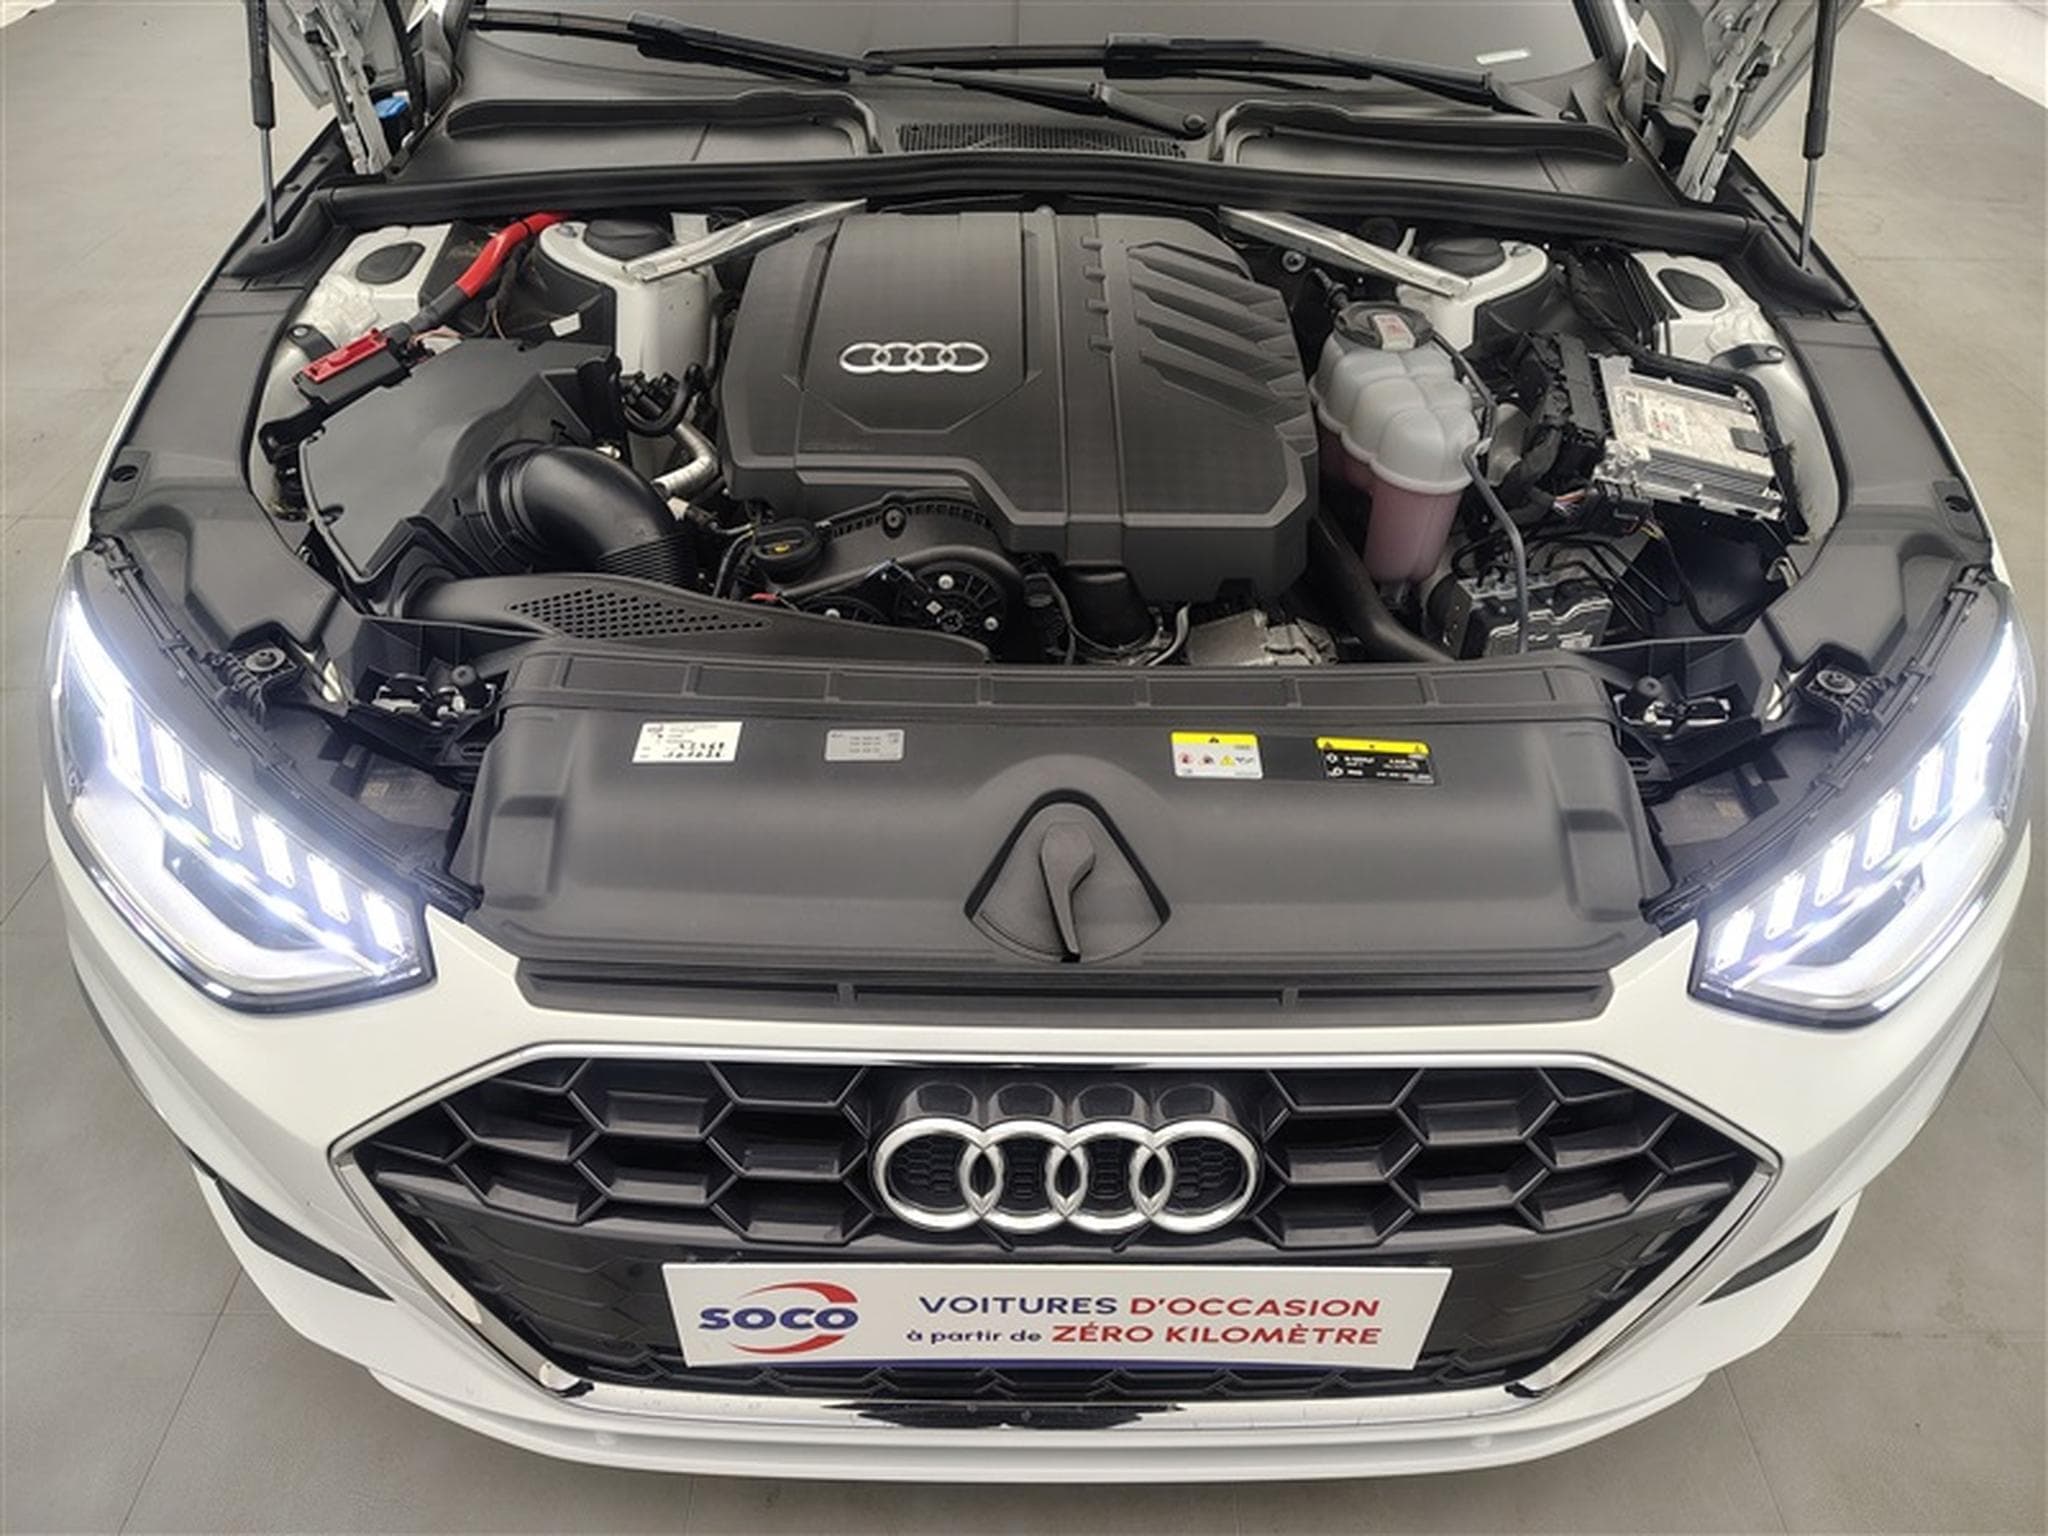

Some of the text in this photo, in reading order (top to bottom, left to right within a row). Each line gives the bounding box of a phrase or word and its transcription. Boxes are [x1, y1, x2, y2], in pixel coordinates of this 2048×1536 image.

[918, 1296, 1381, 1317] VOITURES D'OCCASION
[698, 1307, 859, 1331] SOCO
[906, 1322, 1383, 1346] à partir de ZÉRO KILOMÈTRE
